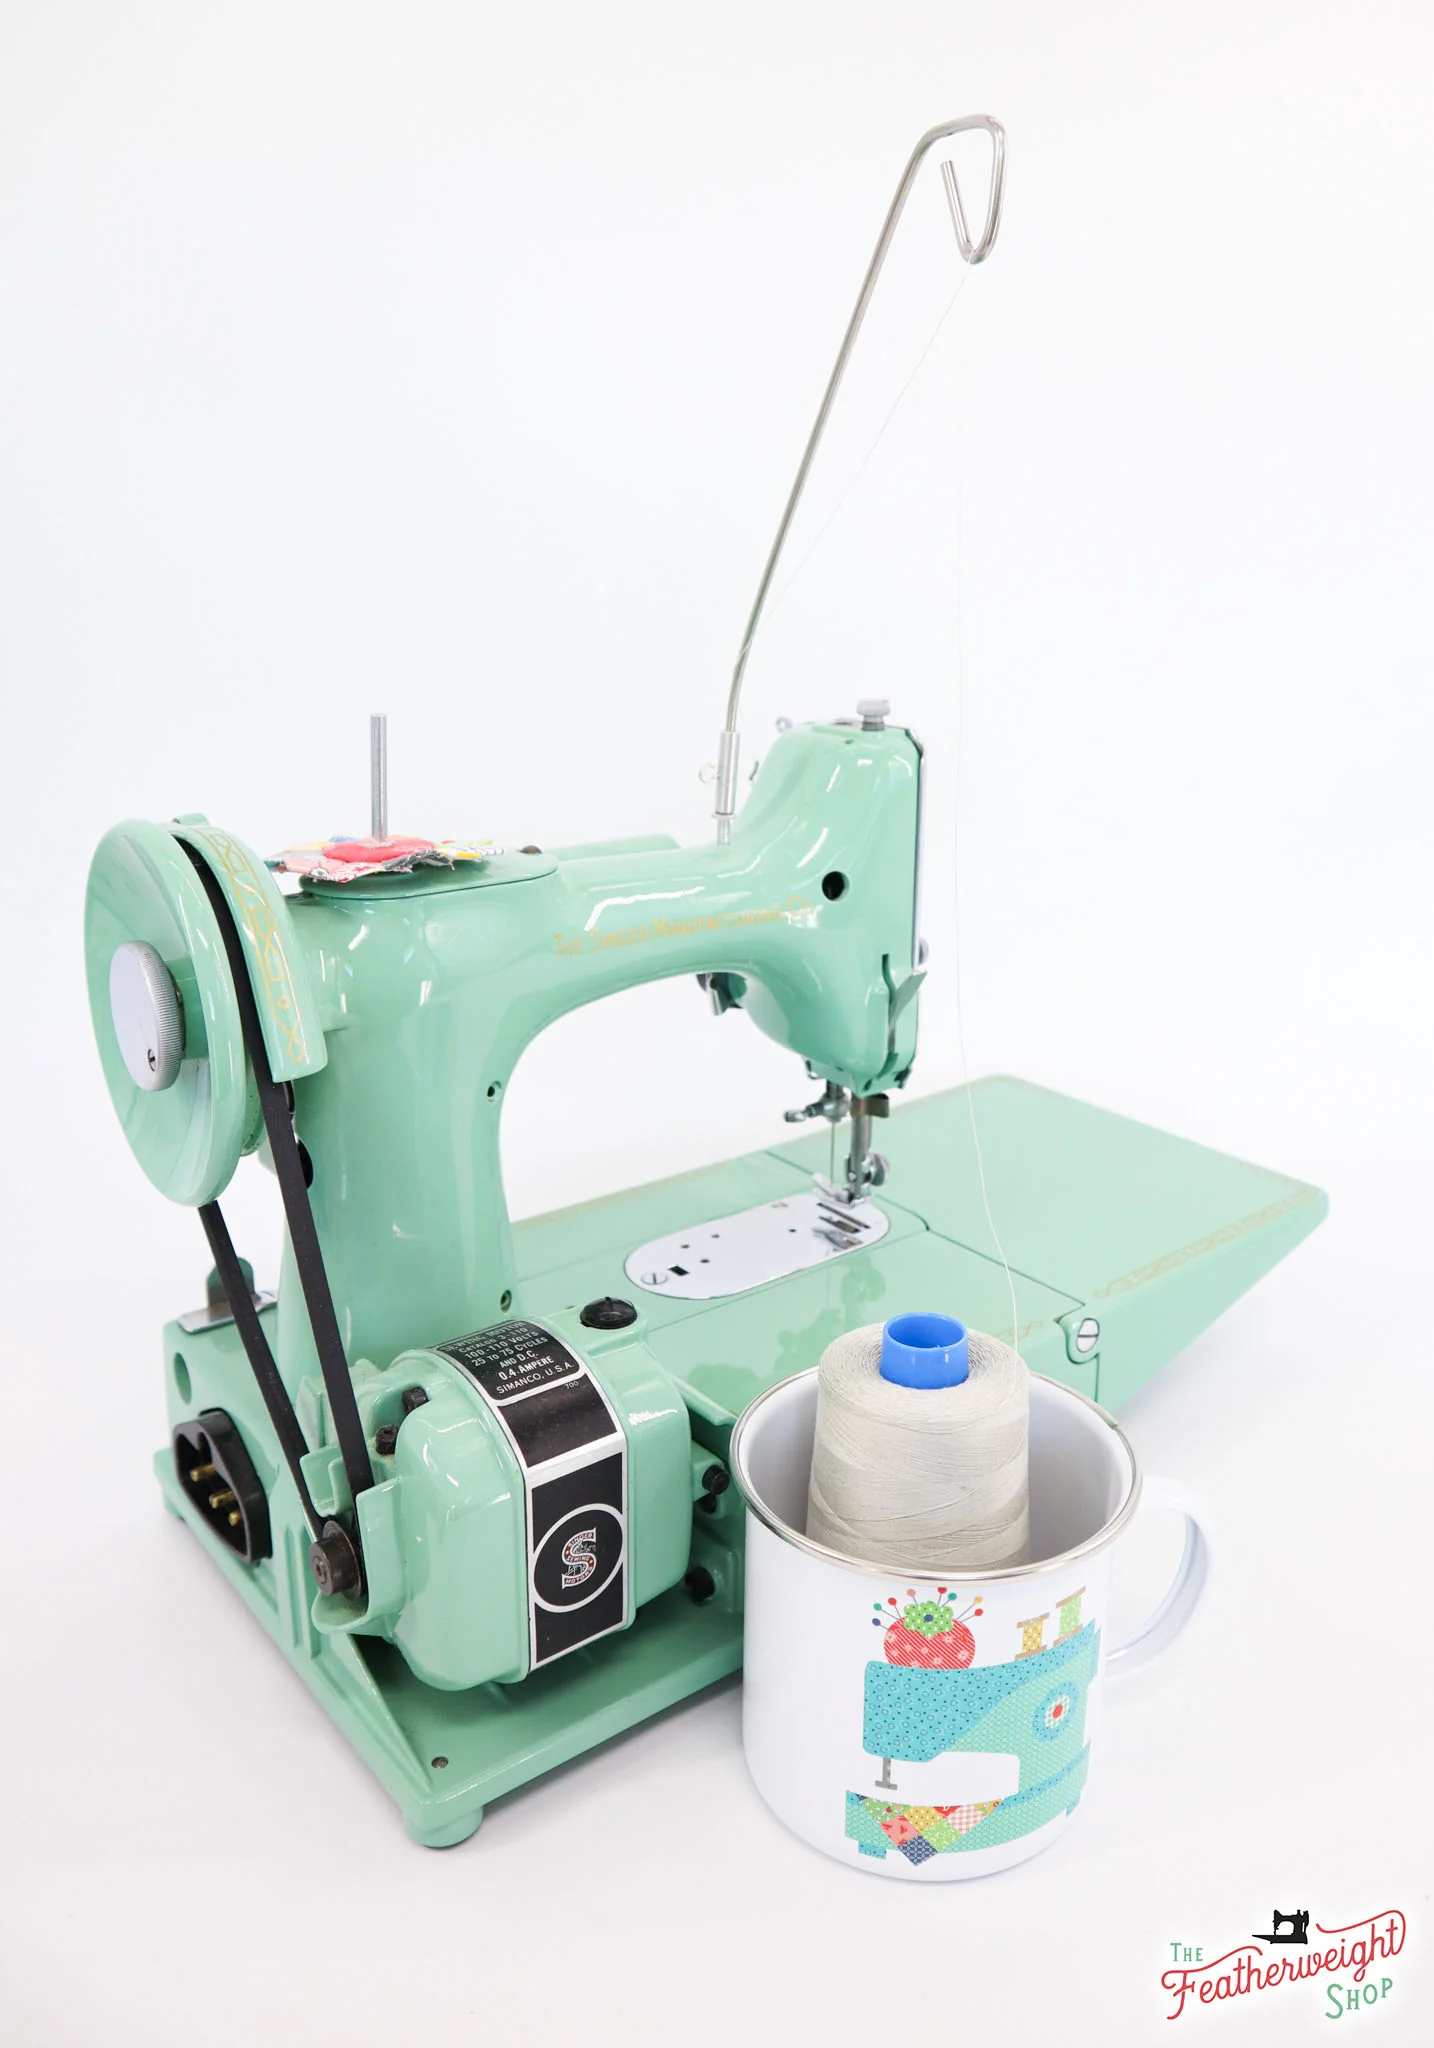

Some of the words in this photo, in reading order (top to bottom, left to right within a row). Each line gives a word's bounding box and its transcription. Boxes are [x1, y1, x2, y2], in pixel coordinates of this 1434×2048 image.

[554, 933, 585, 958] THE
[589, 925, 650, 952] SINGER
[652, 905, 783, 939] MANUFACTURING
[465, 1341, 508, 1359] 100-110
[509, 1331, 539, 1344] VOLTS
[471, 1358, 487, 1367] 25
[500, 1347, 514, 1357] 75
[515, 1337, 548, 1352] CYCLES
[499, 1357, 517, 1369] AND
[517, 1350, 539, 1361] D.C.
[518, 1355, 555, 1374] AMPERE
[568, 1533, 593, 1546] SINGER
[565, 1566, 593, 1583] MOTORS
